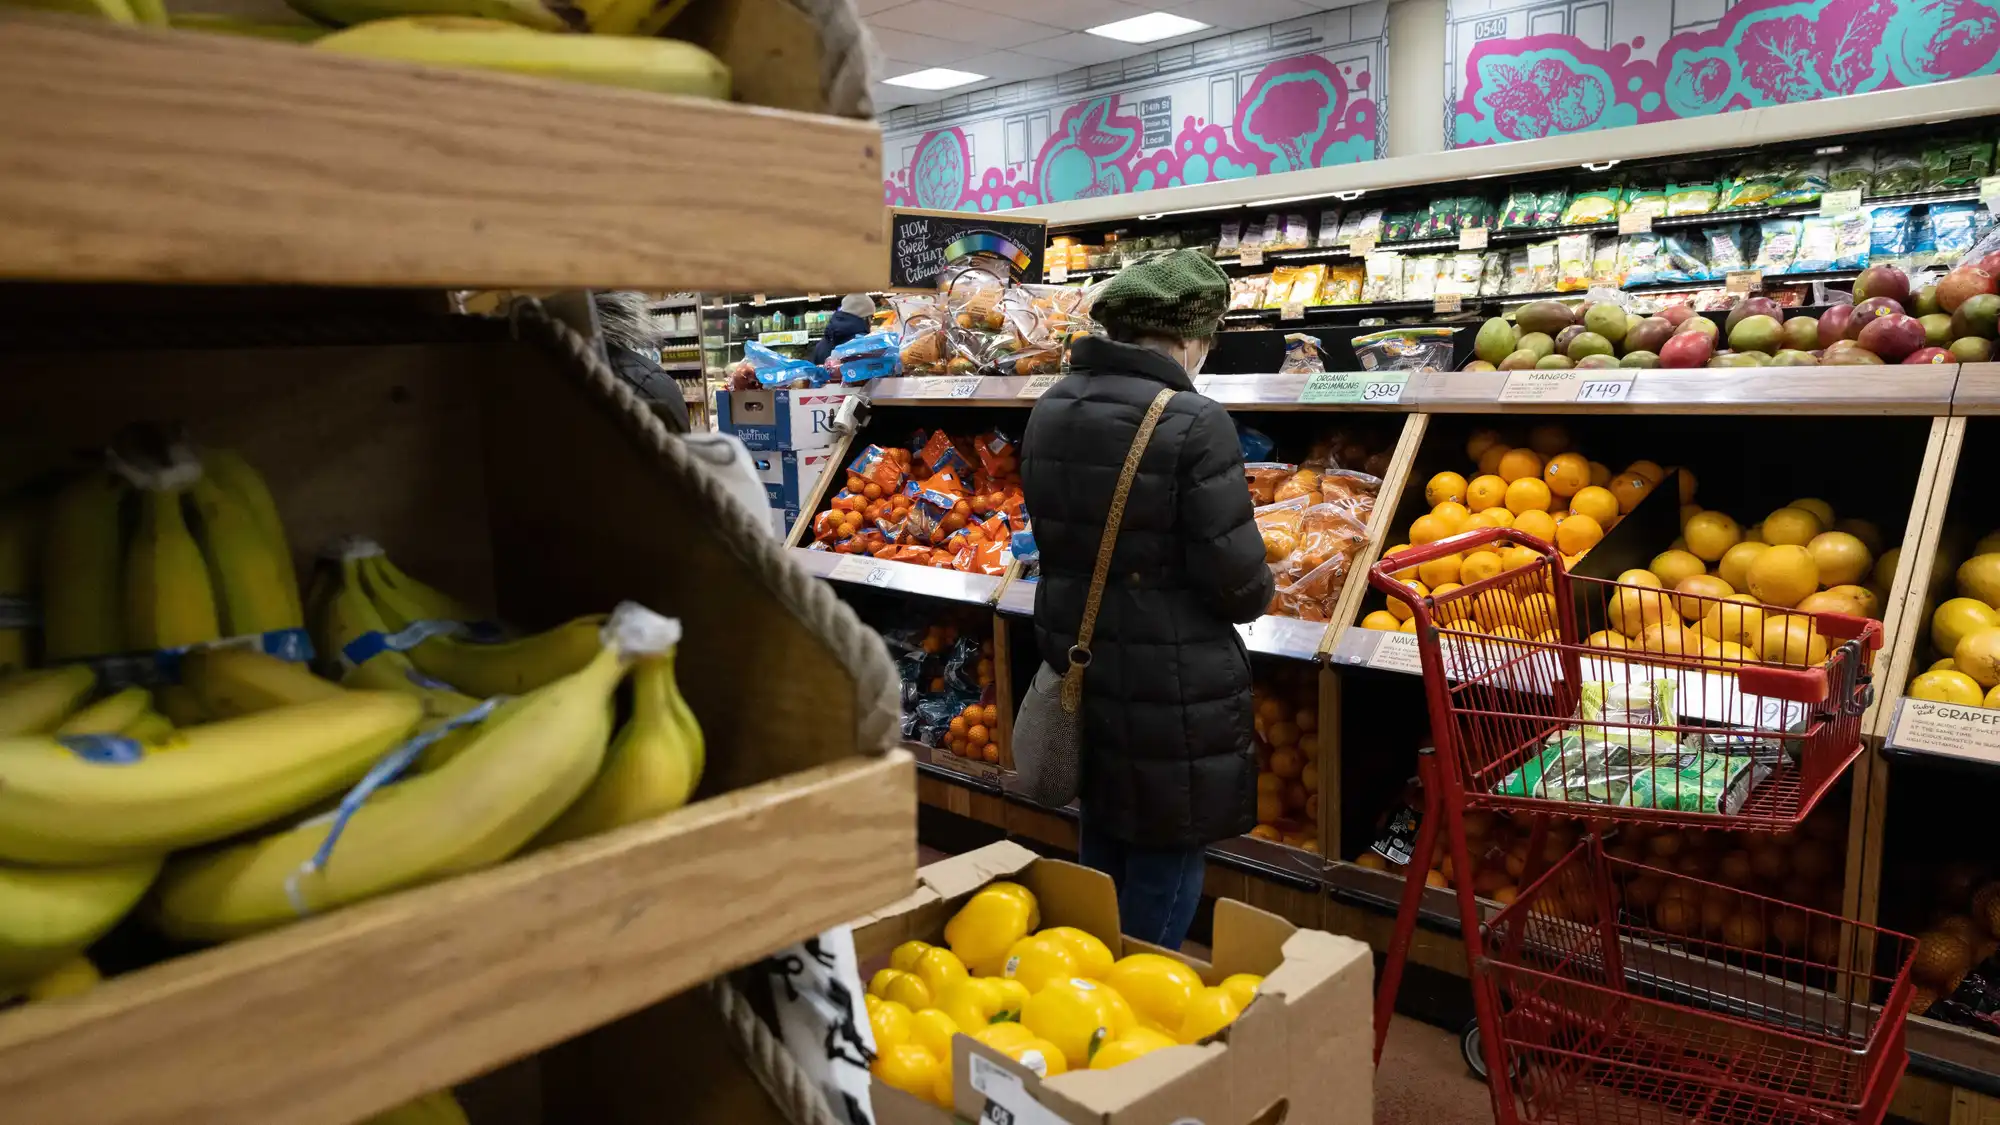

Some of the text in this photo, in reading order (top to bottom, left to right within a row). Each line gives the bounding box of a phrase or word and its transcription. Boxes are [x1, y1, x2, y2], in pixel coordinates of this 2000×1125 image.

[1476, 19, 1505, 38] 0540
[1161, 100, 1170, 109] St
[1145, 134, 1164, 145] Local
[900, 220, 929, 239] HOW
[898, 233, 931, 257] Sweet
[945, 231, 967, 245] TART
[1011, 238, 1033, 259] SWEET
[900, 246, 944, 269] IS THAT
[905, 257, 947, 284] Citrus?
[1316, 374, 1349, 382] ORGANIC
[1528, 373, 1577, 381] MANGOS
[1309, 382, 1360, 390] PERSIMMONS
